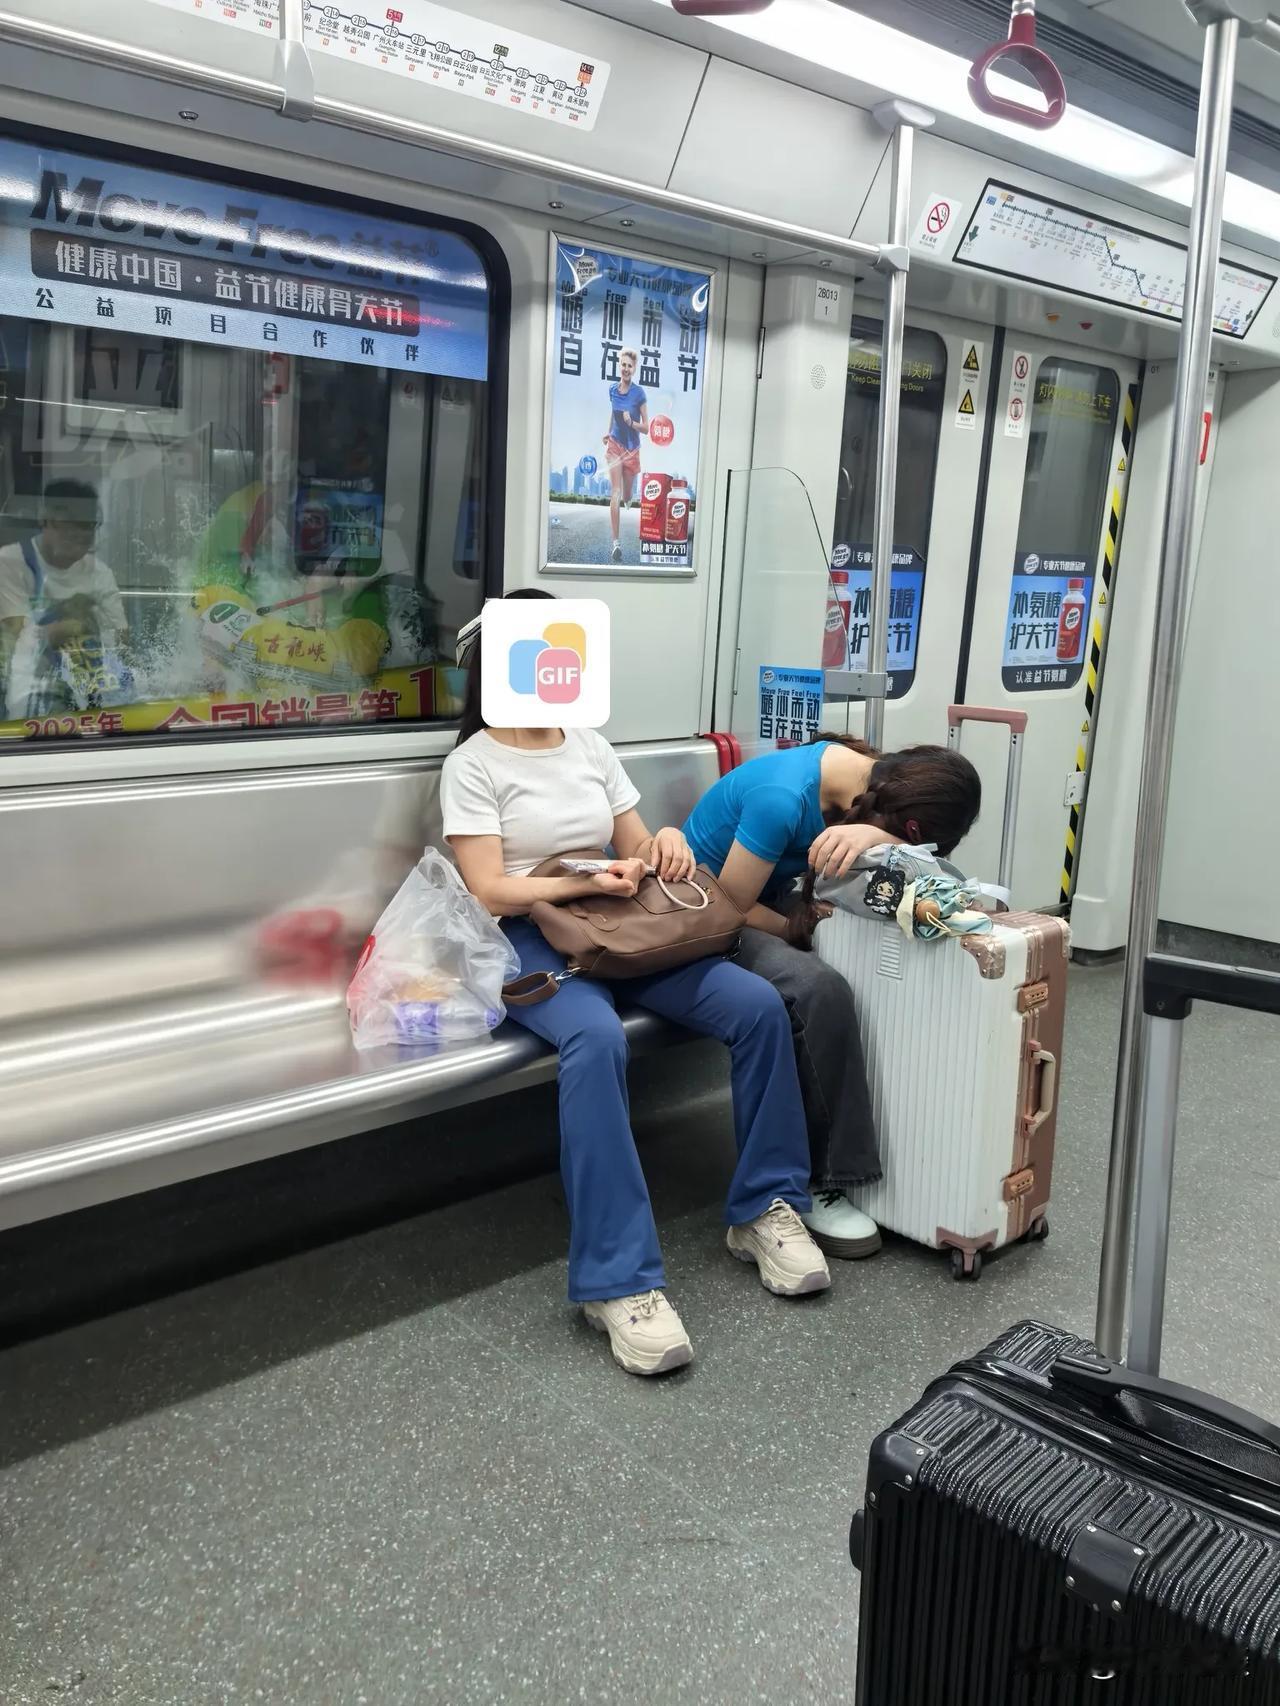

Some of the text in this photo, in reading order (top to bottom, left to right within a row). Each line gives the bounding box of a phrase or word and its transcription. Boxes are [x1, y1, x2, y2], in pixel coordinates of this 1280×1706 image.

[319, 16, 340, 30] 纪念堂
[343, 24, 371, 41] 越秀公园
[373, 34, 405, 50] 广州火车站
[405, 44, 427, 58] 三元里
[428, 51, 453, 66] 飞翔公园
[453, 60, 479, 74] 白云公园
[480, 67, 513, 82] 白云文化广场
[533, 85, 546, 95] 江夏
[606, 288, 627, 305] Free
[1012, 590, 1063, 619] 补氨糖
[1008, 622, 1060, 650] 护关节
[761, 694, 820, 721] 随心而动
